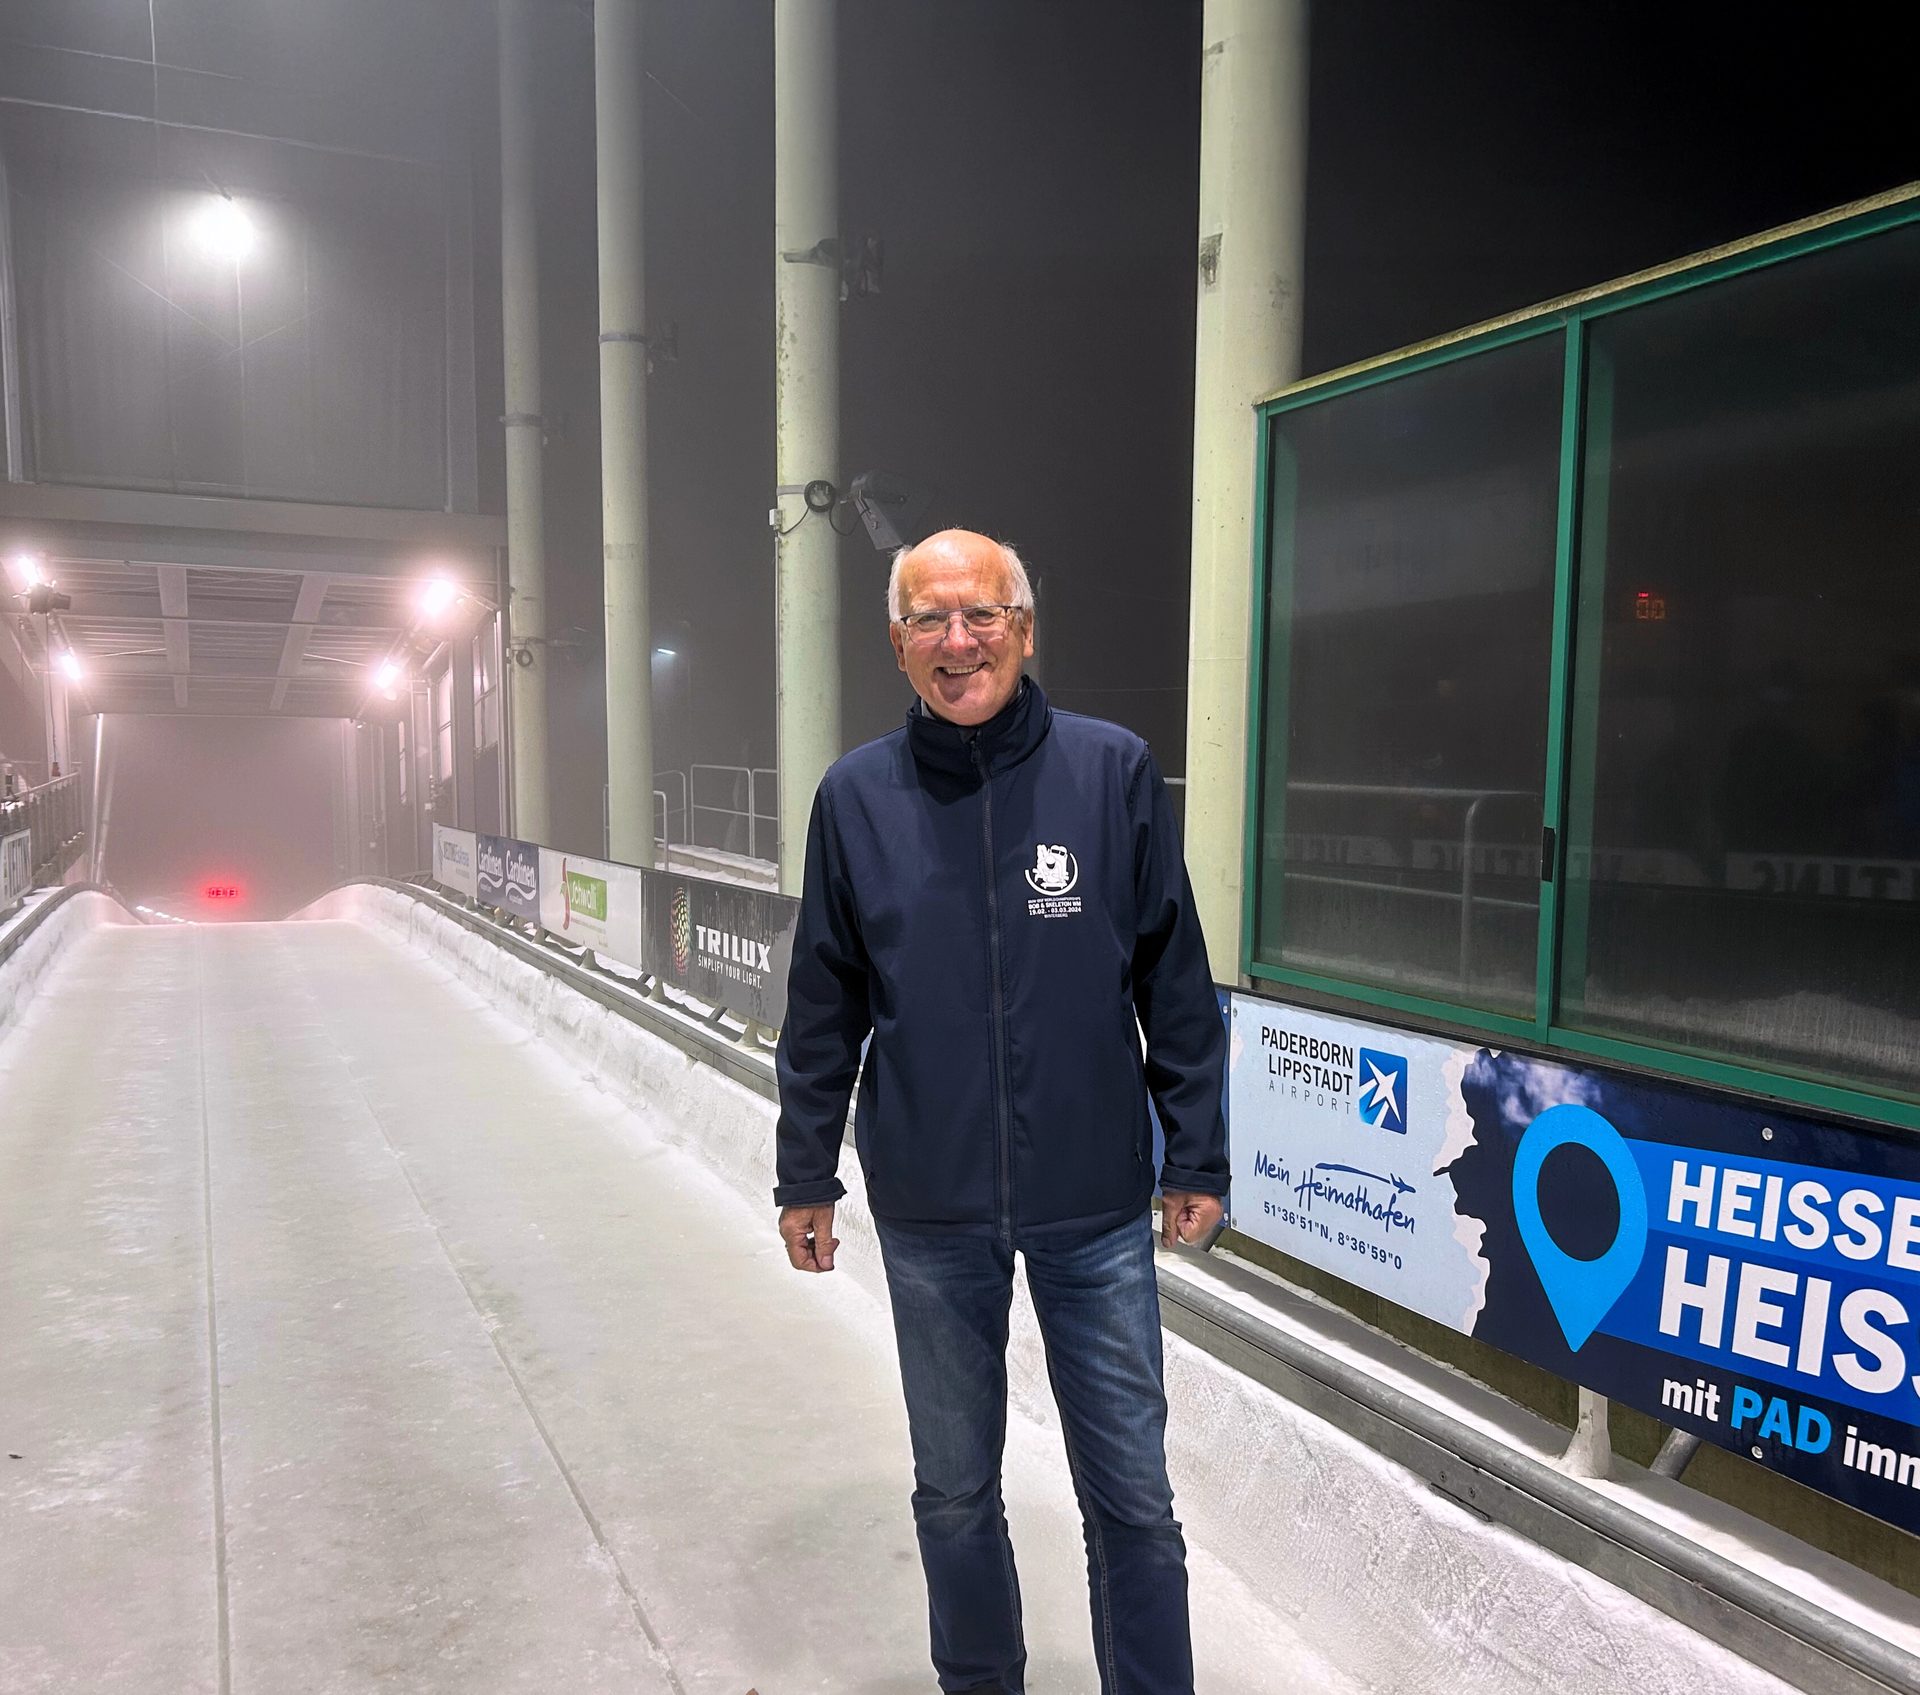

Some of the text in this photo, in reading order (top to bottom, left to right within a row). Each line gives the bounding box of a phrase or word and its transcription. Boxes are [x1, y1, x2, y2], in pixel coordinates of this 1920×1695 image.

[695, 924, 771, 973] TRILUX
[698, 954, 762, 989] SIMPLIFY YOUR LIGHT.
[1261, 1026, 1354, 1068] PADERBORN
[1268, 1054, 1353, 1095] LIPPSTADT
[1268, 1080, 1351, 1114] AIRPORT
[1254, 1150, 1290, 1186] Mein
[1294, 1168, 1415, 1234] Heimathafen
[1666, 1160, 1920, 1272] HEISSE
[1658, 1245, 1920, 1401] HEIS
[1661, 1378, 1721, 1422] mit
[1730, 1385, 1832, 1454] PAD
